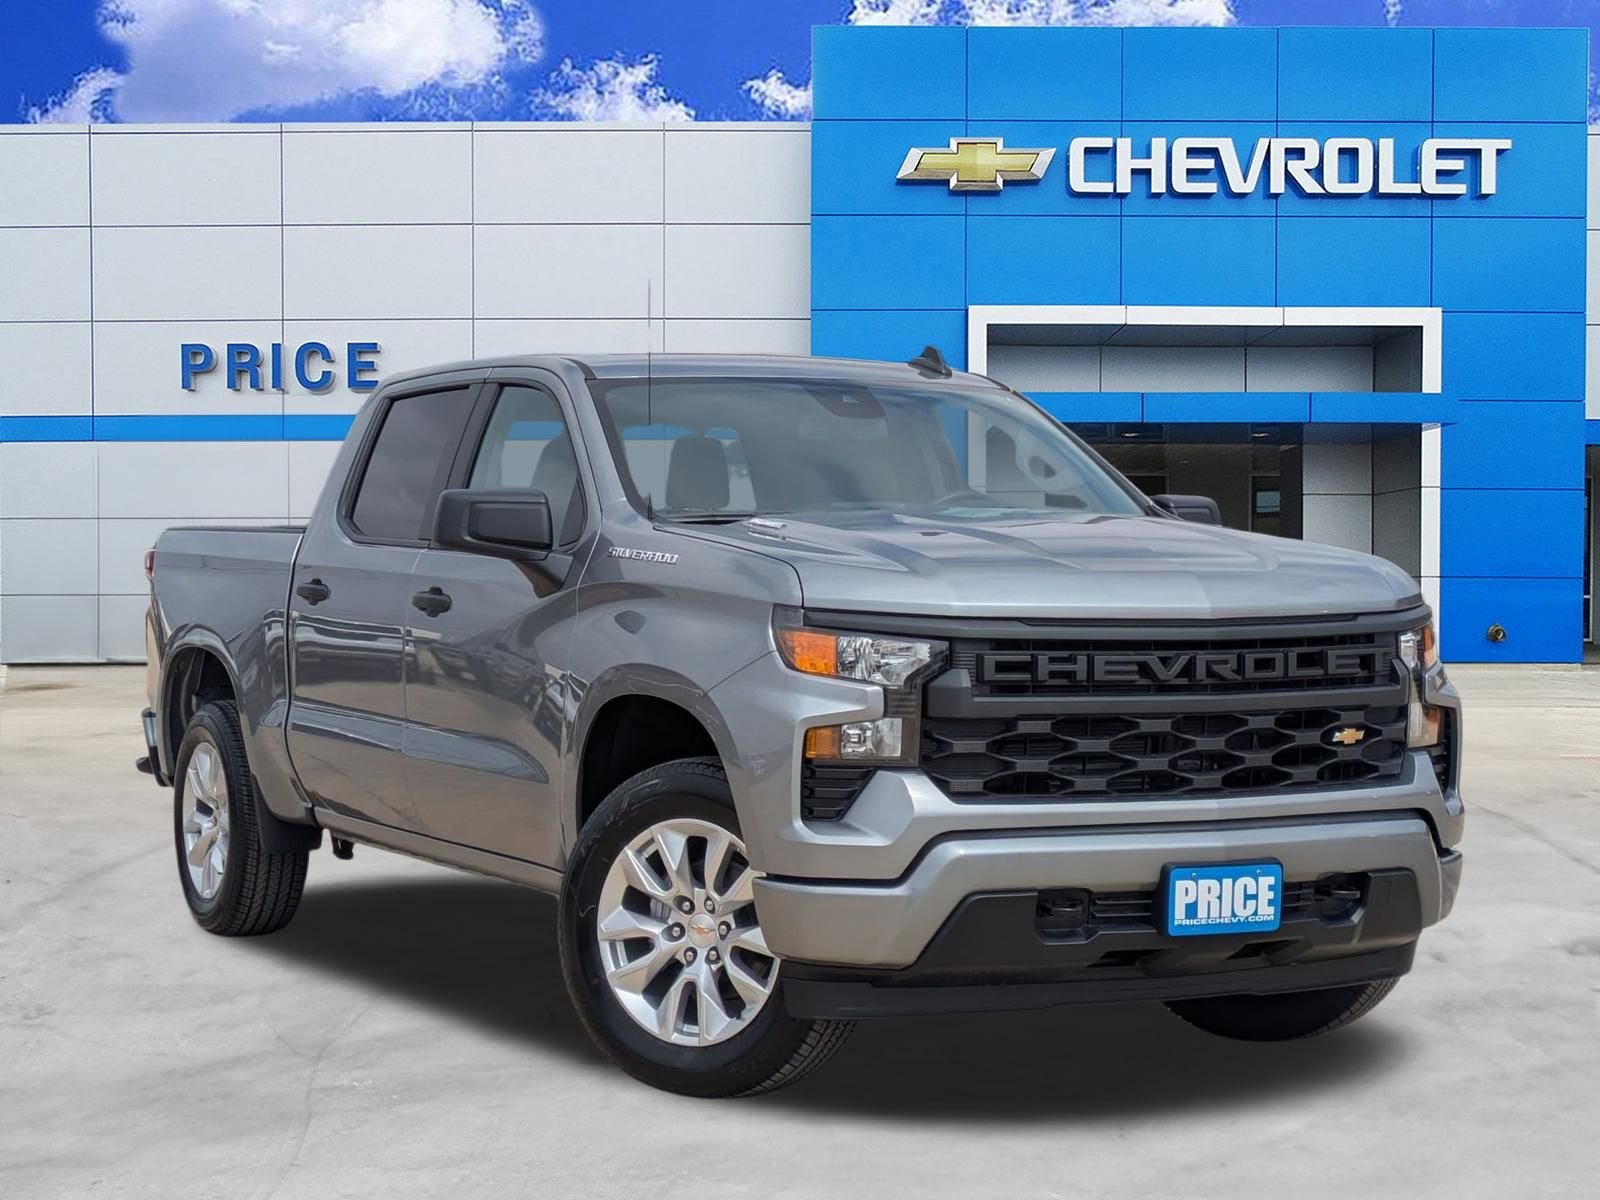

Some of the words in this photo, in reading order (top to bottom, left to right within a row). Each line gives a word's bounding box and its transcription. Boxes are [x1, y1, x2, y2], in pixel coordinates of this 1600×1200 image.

[1068, 137, 1512, 196] CHEVROLET
[180, 341, 381, 392] PRICE
[608, 546, 679, 565] SILVERADO
[979, 648, 1393, 683] CHEVROLET
[1174, 876, 1276, 919] PRICE
[1174, 914, 1274, 926] PRICECHEVY.COM
